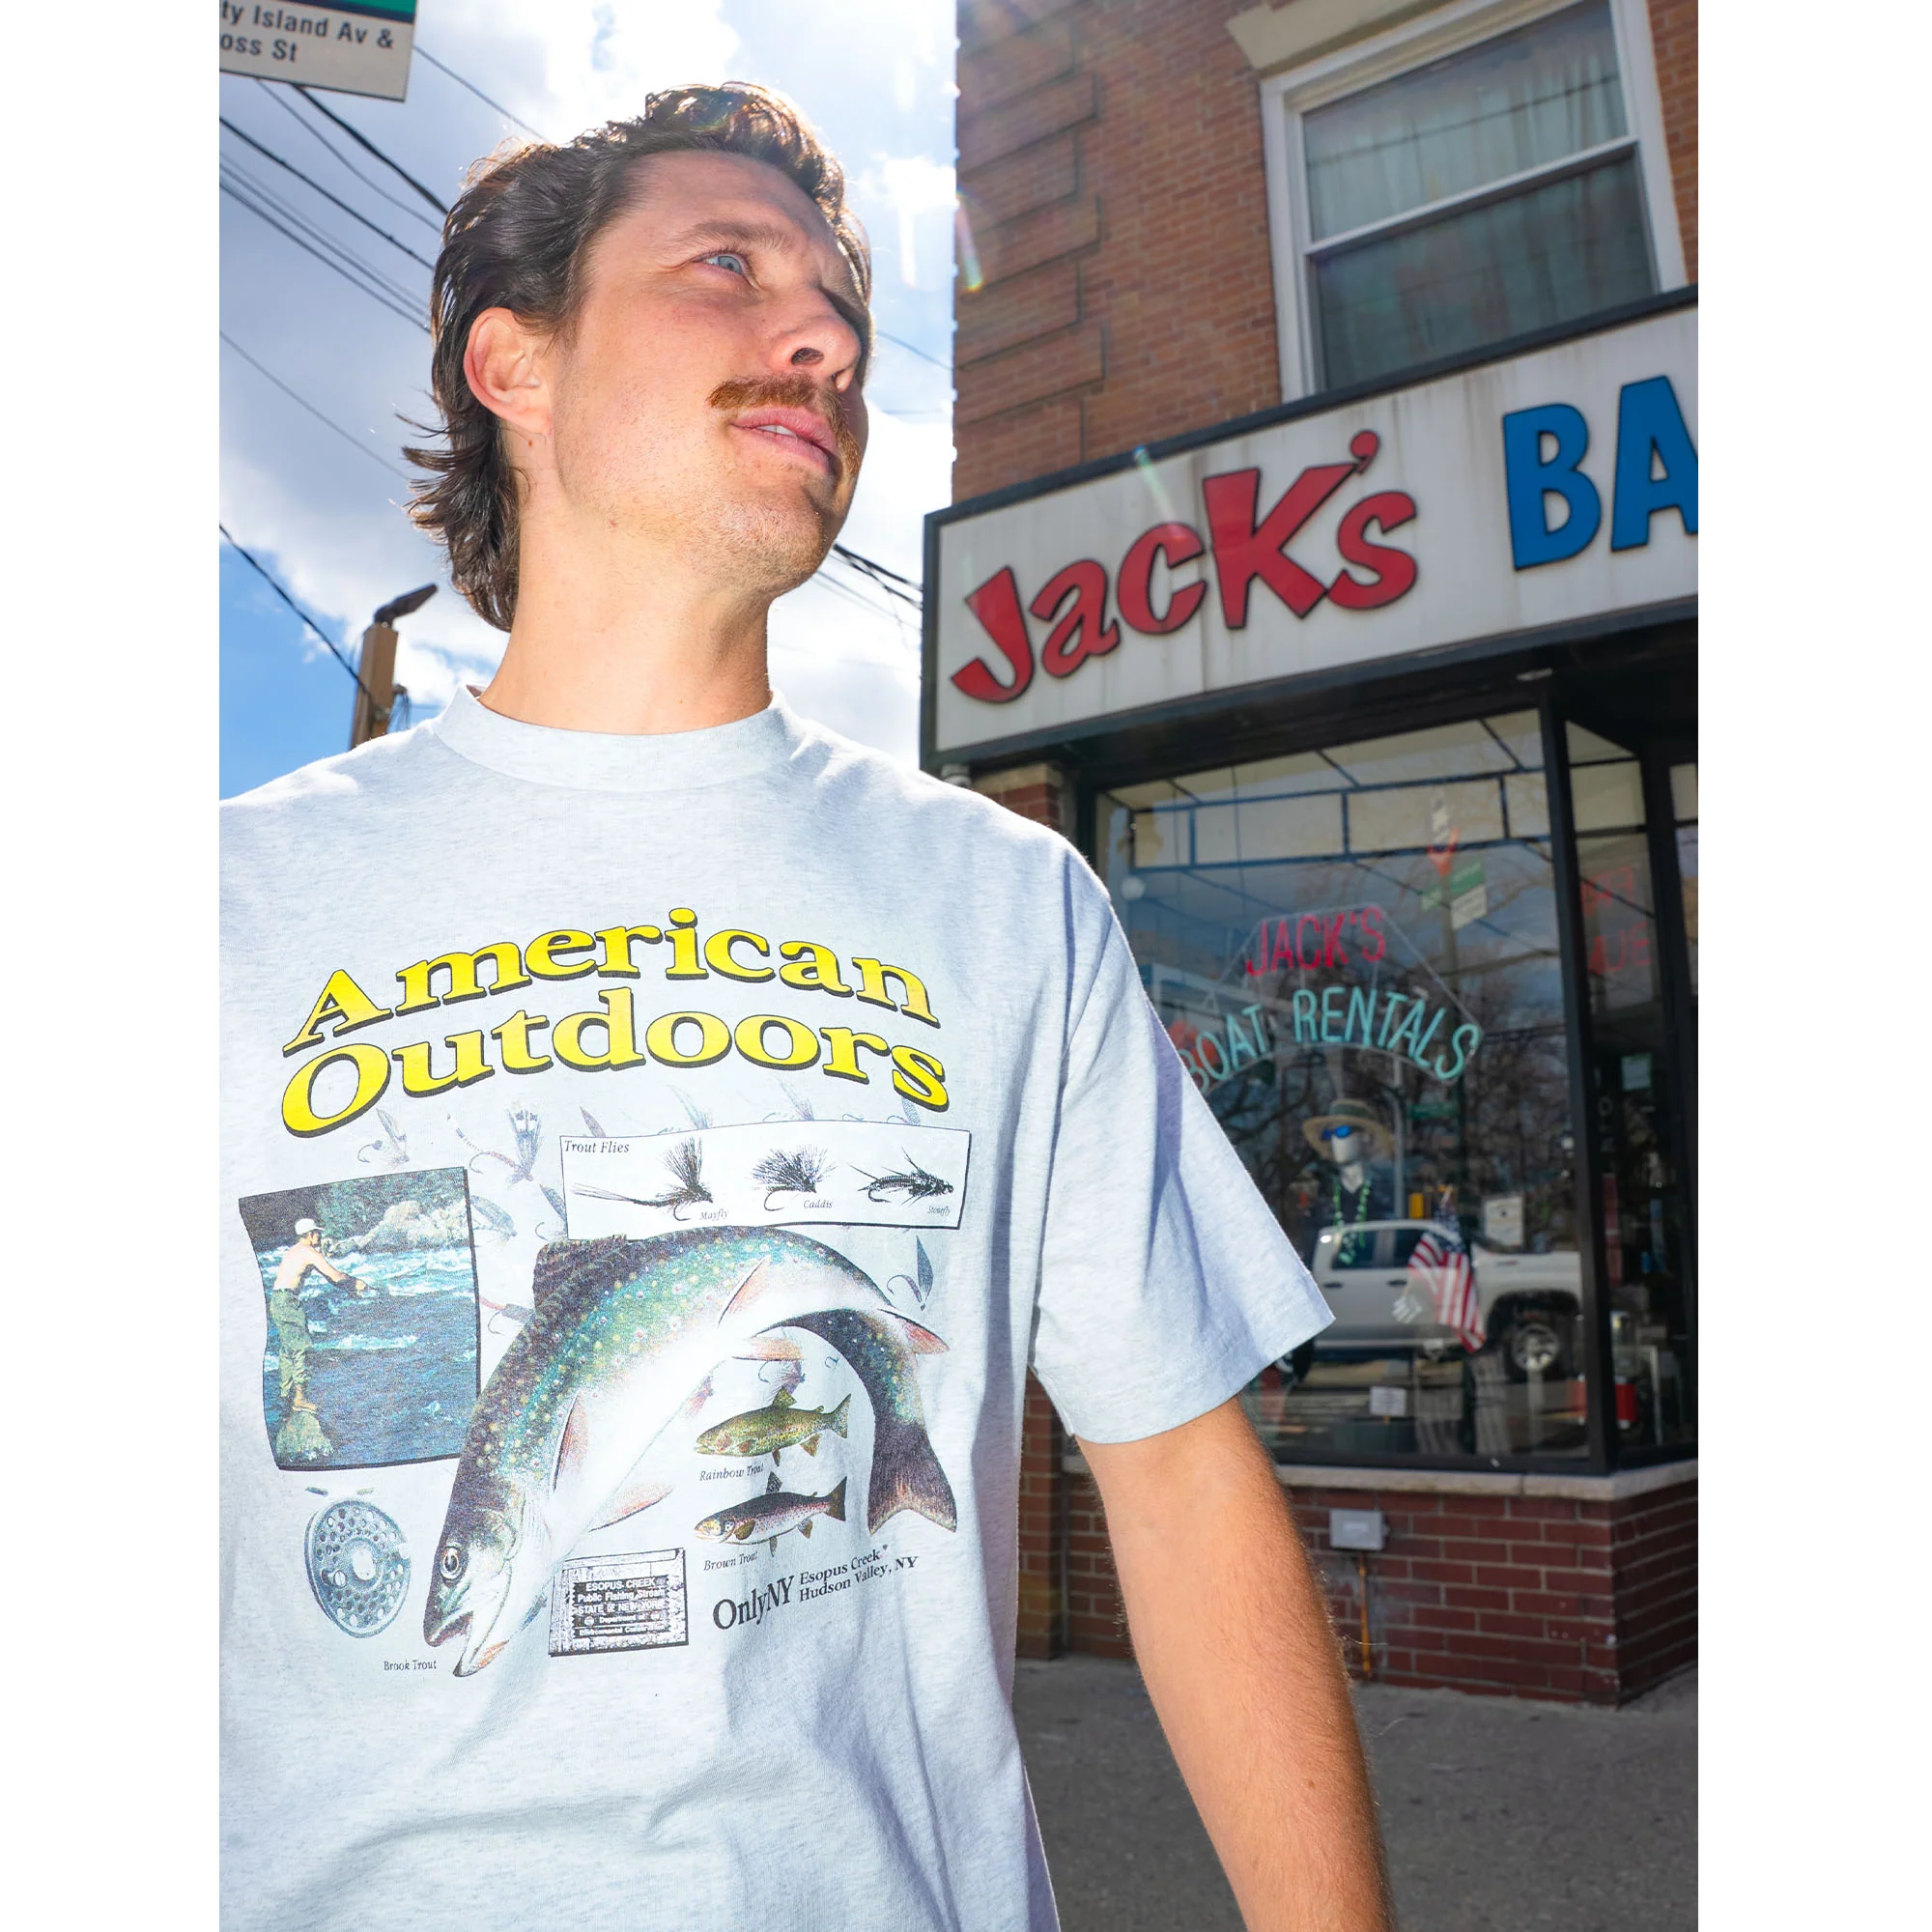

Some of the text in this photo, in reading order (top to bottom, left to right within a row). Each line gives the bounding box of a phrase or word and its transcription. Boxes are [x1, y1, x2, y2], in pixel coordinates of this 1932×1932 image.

[253, 4, 328, 38] Island
[338, 21, 367, 43] Av
[377, 28, 393, 48] &
[271, 39, 298, 62] St
[1246, 906, 1385, 977] JACK'S
[282, 907, 942, 1061] American
[1293, 985, 1482, 1081] RENTALS
[281, 986, 951, 1139] Outdoors
[565, 1140, 630, 1153] Trout Flies
[699, 1208, 728, 1221] Mayfly
[803, 1199, 833, 1209] Caddis
[699, 1467, 745, 1482] Rainbow
[703, 1550, 758, 1572] Brown Trout
[625, 1577, 656, 1589] CREEK
[799, 1555, 919, 1603] Hudson Valley, NY
[800, 1563, 848, 1586] Esopus
[577, 1588, 666, 1605] Public Fishing Stream
[579, 1604, 605, 1615] STATE
[618, 1602, 638, 1612] NEW
[384, 1659, 437, 1671] Brook Trout
